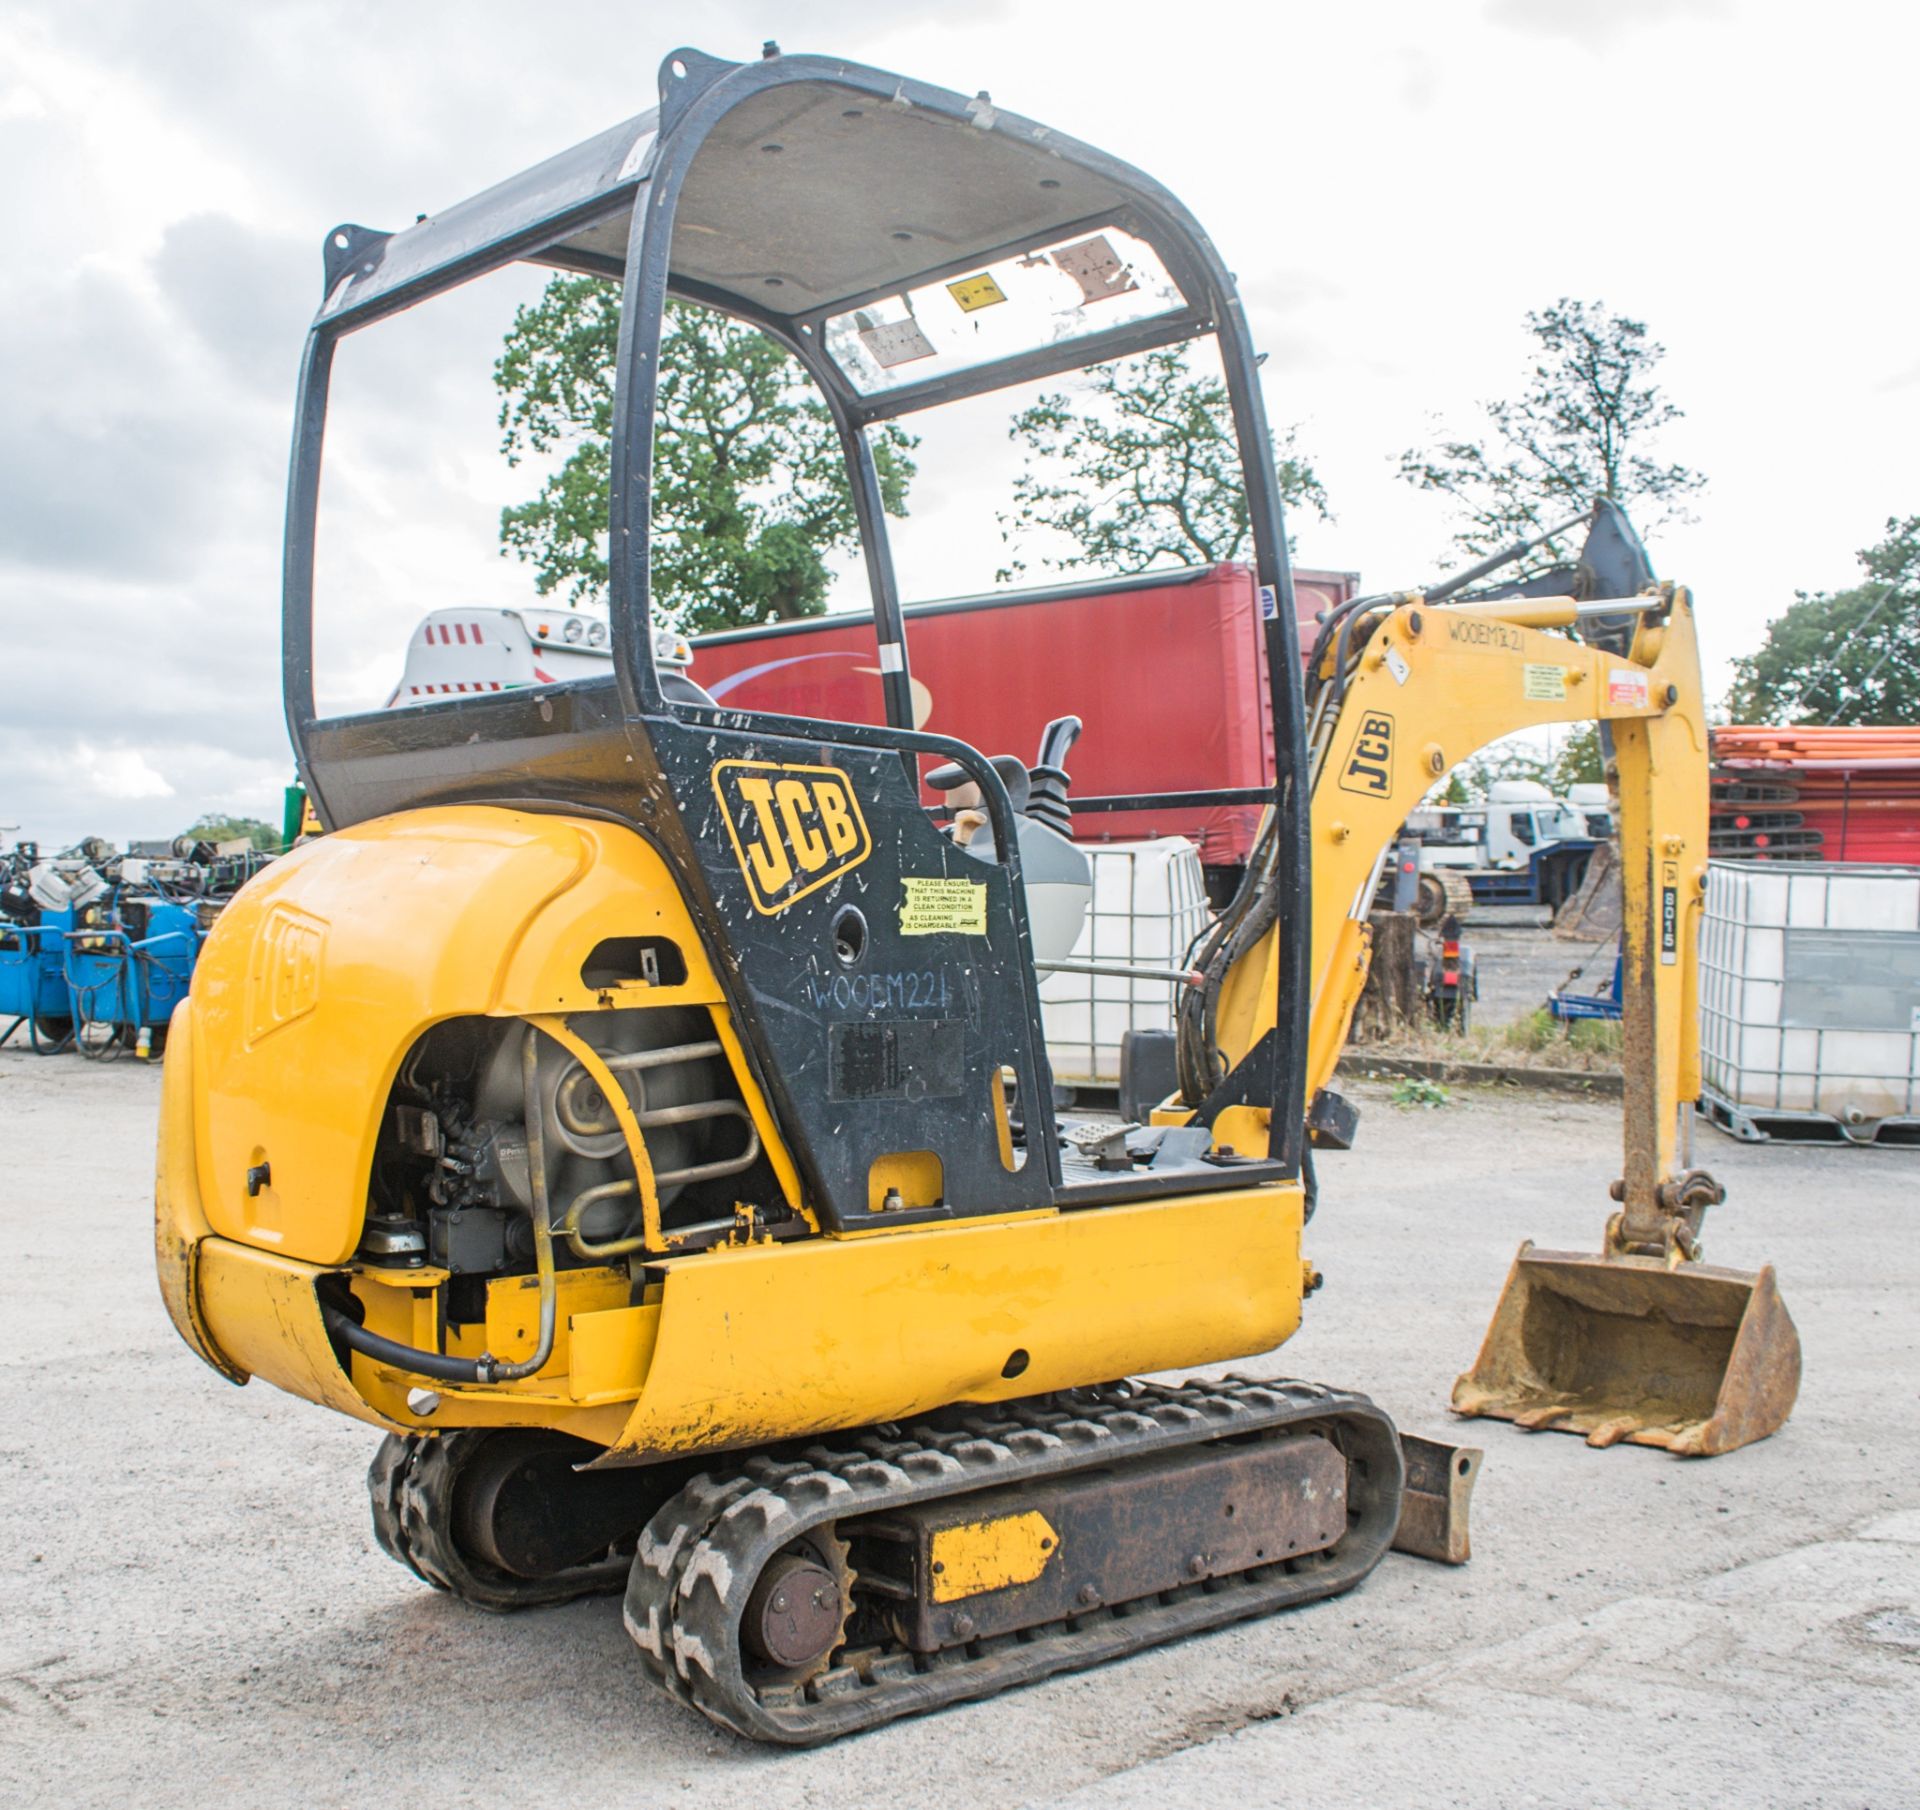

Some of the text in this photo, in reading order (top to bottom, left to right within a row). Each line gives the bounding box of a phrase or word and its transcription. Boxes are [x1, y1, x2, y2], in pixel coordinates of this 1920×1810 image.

[1348, 719, 1391, 791] JCB
[737, 777, 858, 895] JCB
[1664, 892, 1675, 947] 8015
